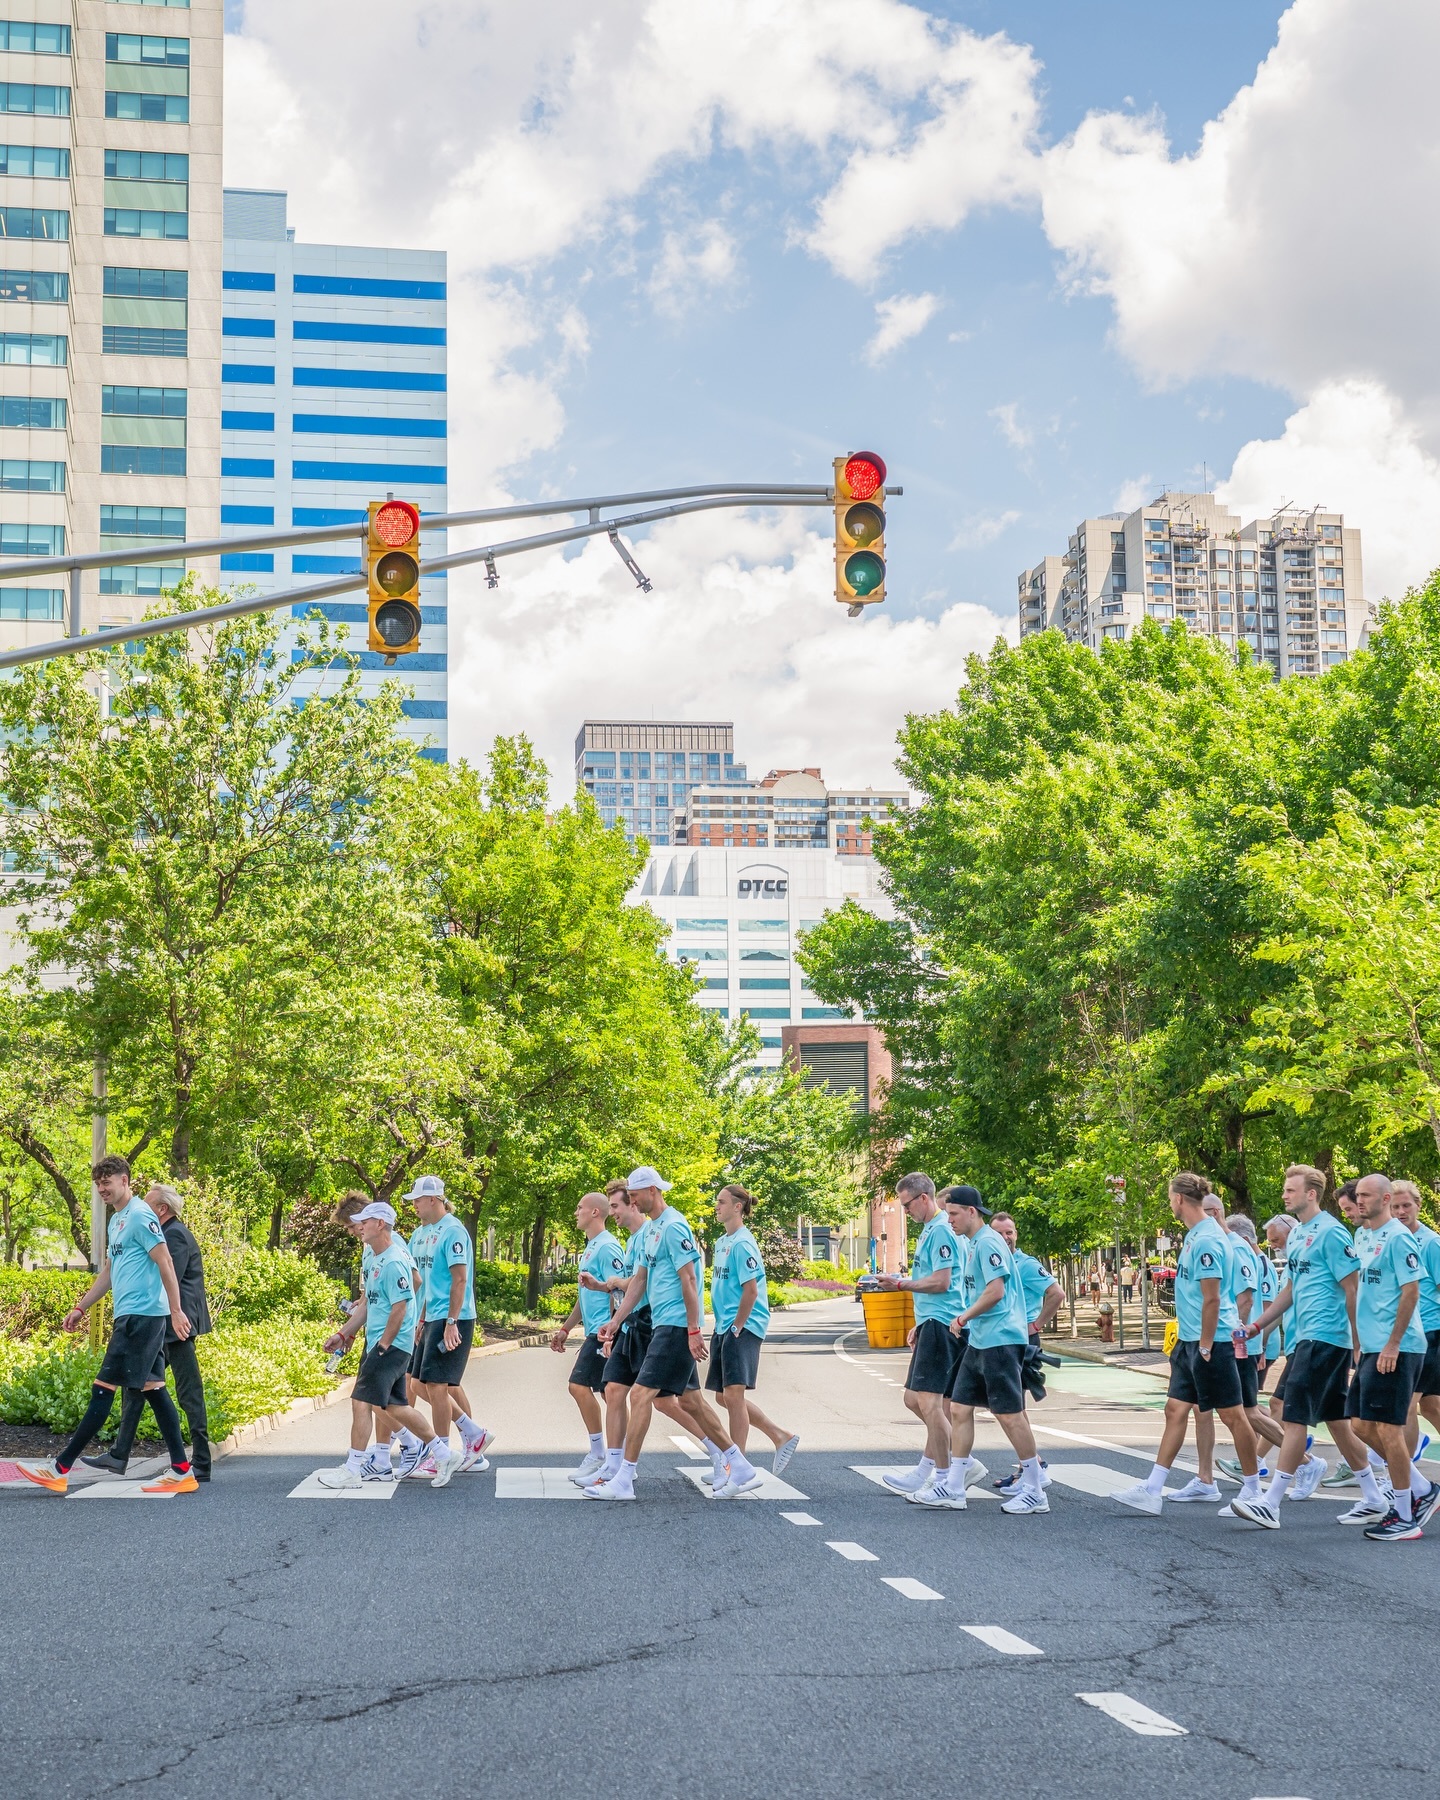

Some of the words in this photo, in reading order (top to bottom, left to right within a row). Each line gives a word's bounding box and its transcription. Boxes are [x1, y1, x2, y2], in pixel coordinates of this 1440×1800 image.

[739, 879, 787, 892] DTCC
[1367, 1267, 1382, 1276] mini
[1367, 1276, 1381, 1285] pris
